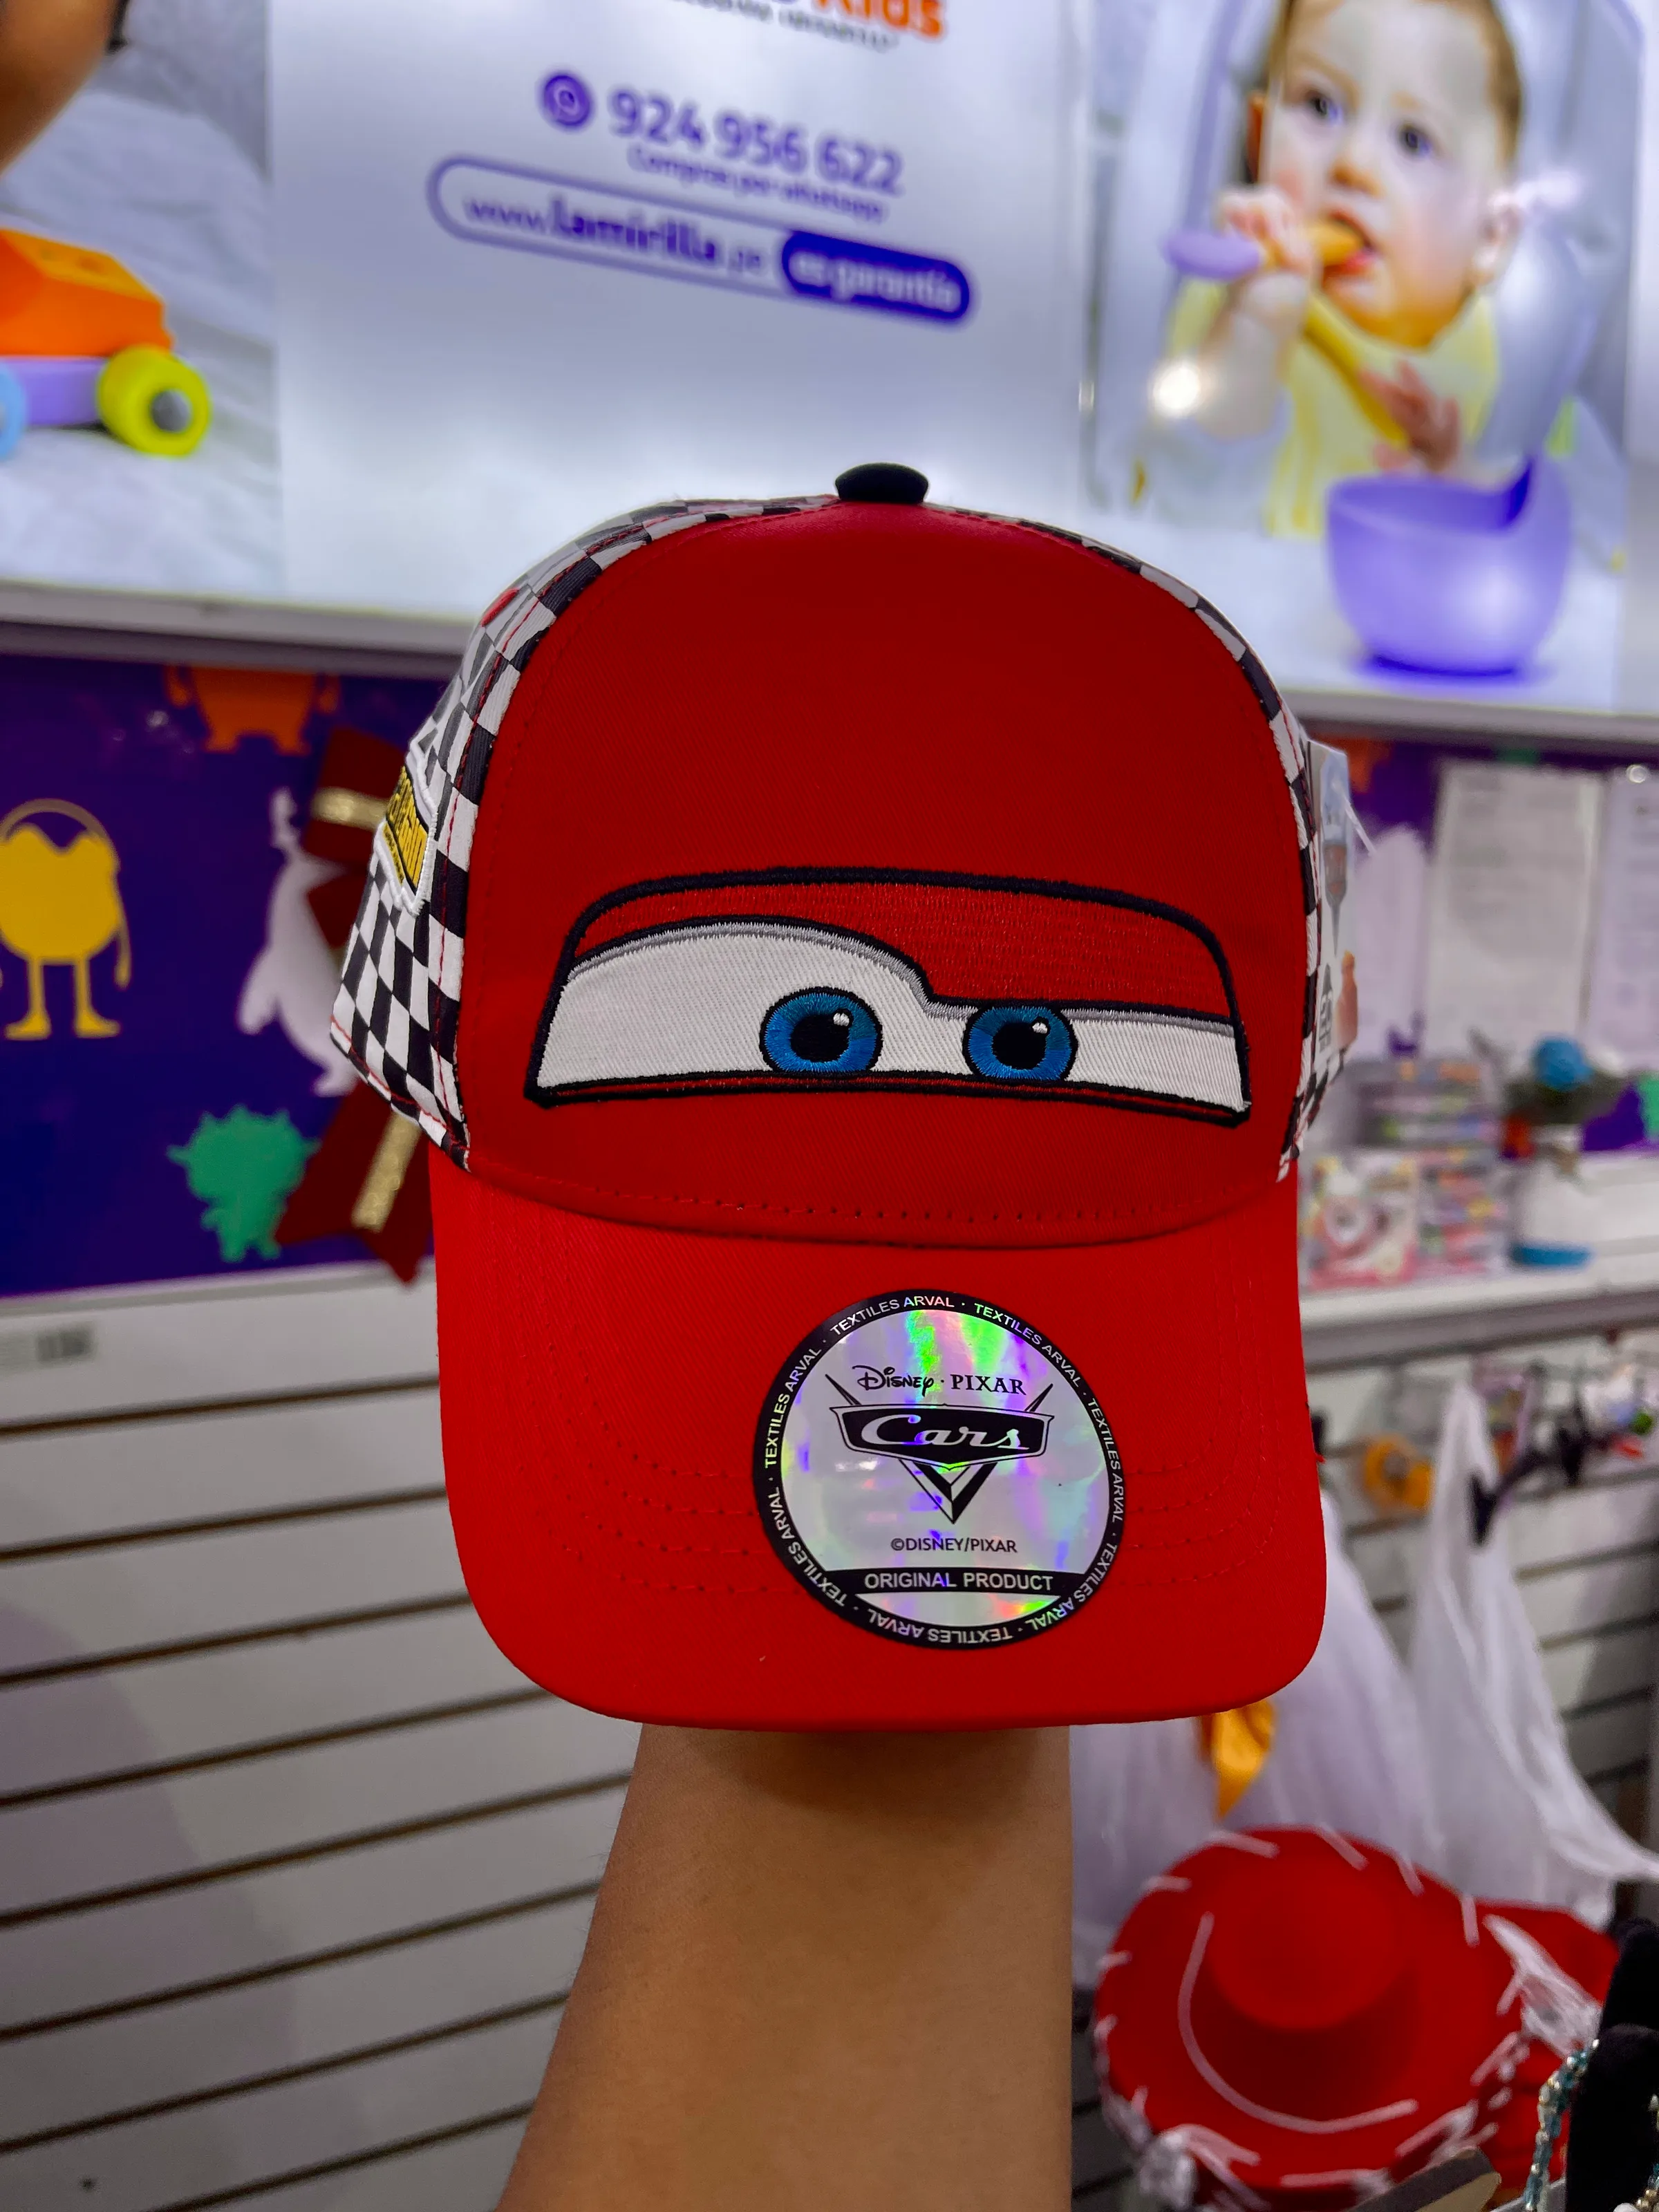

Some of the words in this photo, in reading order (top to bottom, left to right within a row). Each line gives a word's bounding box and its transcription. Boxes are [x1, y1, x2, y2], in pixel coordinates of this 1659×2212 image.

[608, 89, 704, 148] 924
[714, 111, 809, 173] 956
[815, 135, 904, 196] 622
[830, 1299, 899, 1335] TEXTILES
[903, 1295, 955, 1308] ARVAL
[974, 1303, 1042, 1344] TEXTILES
[1042, 1345, 1079, 1387] ARVAL
[765, 1393, 790, 1468] TEXTILES
[785, 1348, 822, 1392] ARVAL
[950, 1374, 1027, 1396] PIXAR
[861, 1414, 1030, 1450] Cars
[1087, 1398, 1121, 1470] TEXTILES
[1112, 1472, 1124, 1523] ARVAL
[768, 1487, 795, 1539] ARVAL
[788, 1541, 847, 1606] TEXTILES
[864, 1572, 957, 1589] ORIGINAL
[963, 1573, 1053, 1591] PRODUCT
[1074, 1542, 1116, 1602] TEXTILES
[868, 1608, 924, 1638] ARVAL
[927, 1626, 1013, 1644] TEXTILES
[1025, 1596, 1075, 1630] ARVAL
